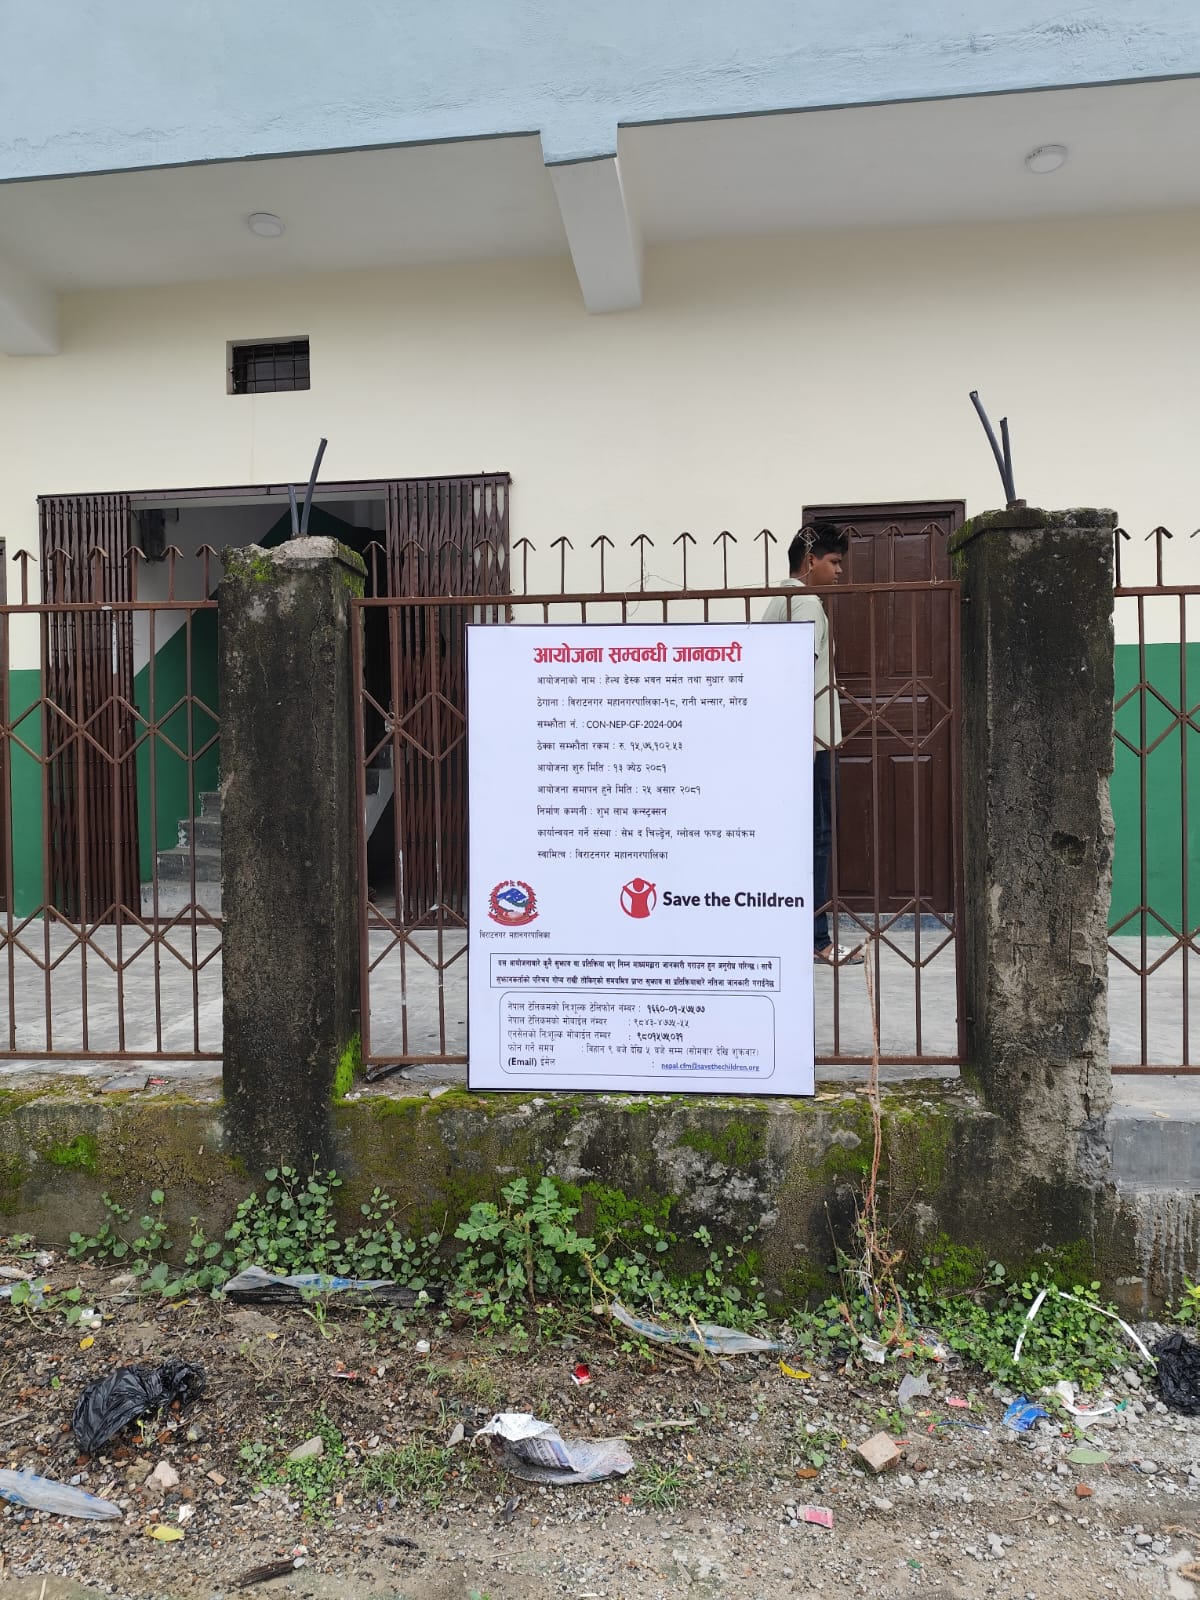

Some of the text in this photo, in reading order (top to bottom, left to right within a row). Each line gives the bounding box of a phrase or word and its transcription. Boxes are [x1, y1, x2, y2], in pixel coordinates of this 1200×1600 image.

[533, 641, 743, 664] आयोजना सम्वन्धी जानकारी
[581, 676, 596, 685] नाम
[687, 676, 702, 685] तथा
[537, 696, 559, 707] ठेगाना
[681, 696, 697, 707] रानी
[586, 720, 683, 729] CON-NEP-GF-2024-004
[537, 739, 556, 751] ठेक्का
[592, 742, 610, 751] रकम
[537, 761, 569, 773] आयोजना
[587, 761, 604, 773] मिति
[613, 763, 623, 773] १३
[645, 763, 667, 774] २०८१
[537, 783, 569, 795] आयोजना
[615, 783, 632, 795] मिति
[679, 785, 701, 795] २०८१
[563, 804, 587, 816] कम्पनी
[613, 807, 629, 816] लाभ
[614, 848, 668, 860] महानगरपालिका
[662, 891, 805, 908] Save the Children
[507, 1058, 537, 1067] (Email)
